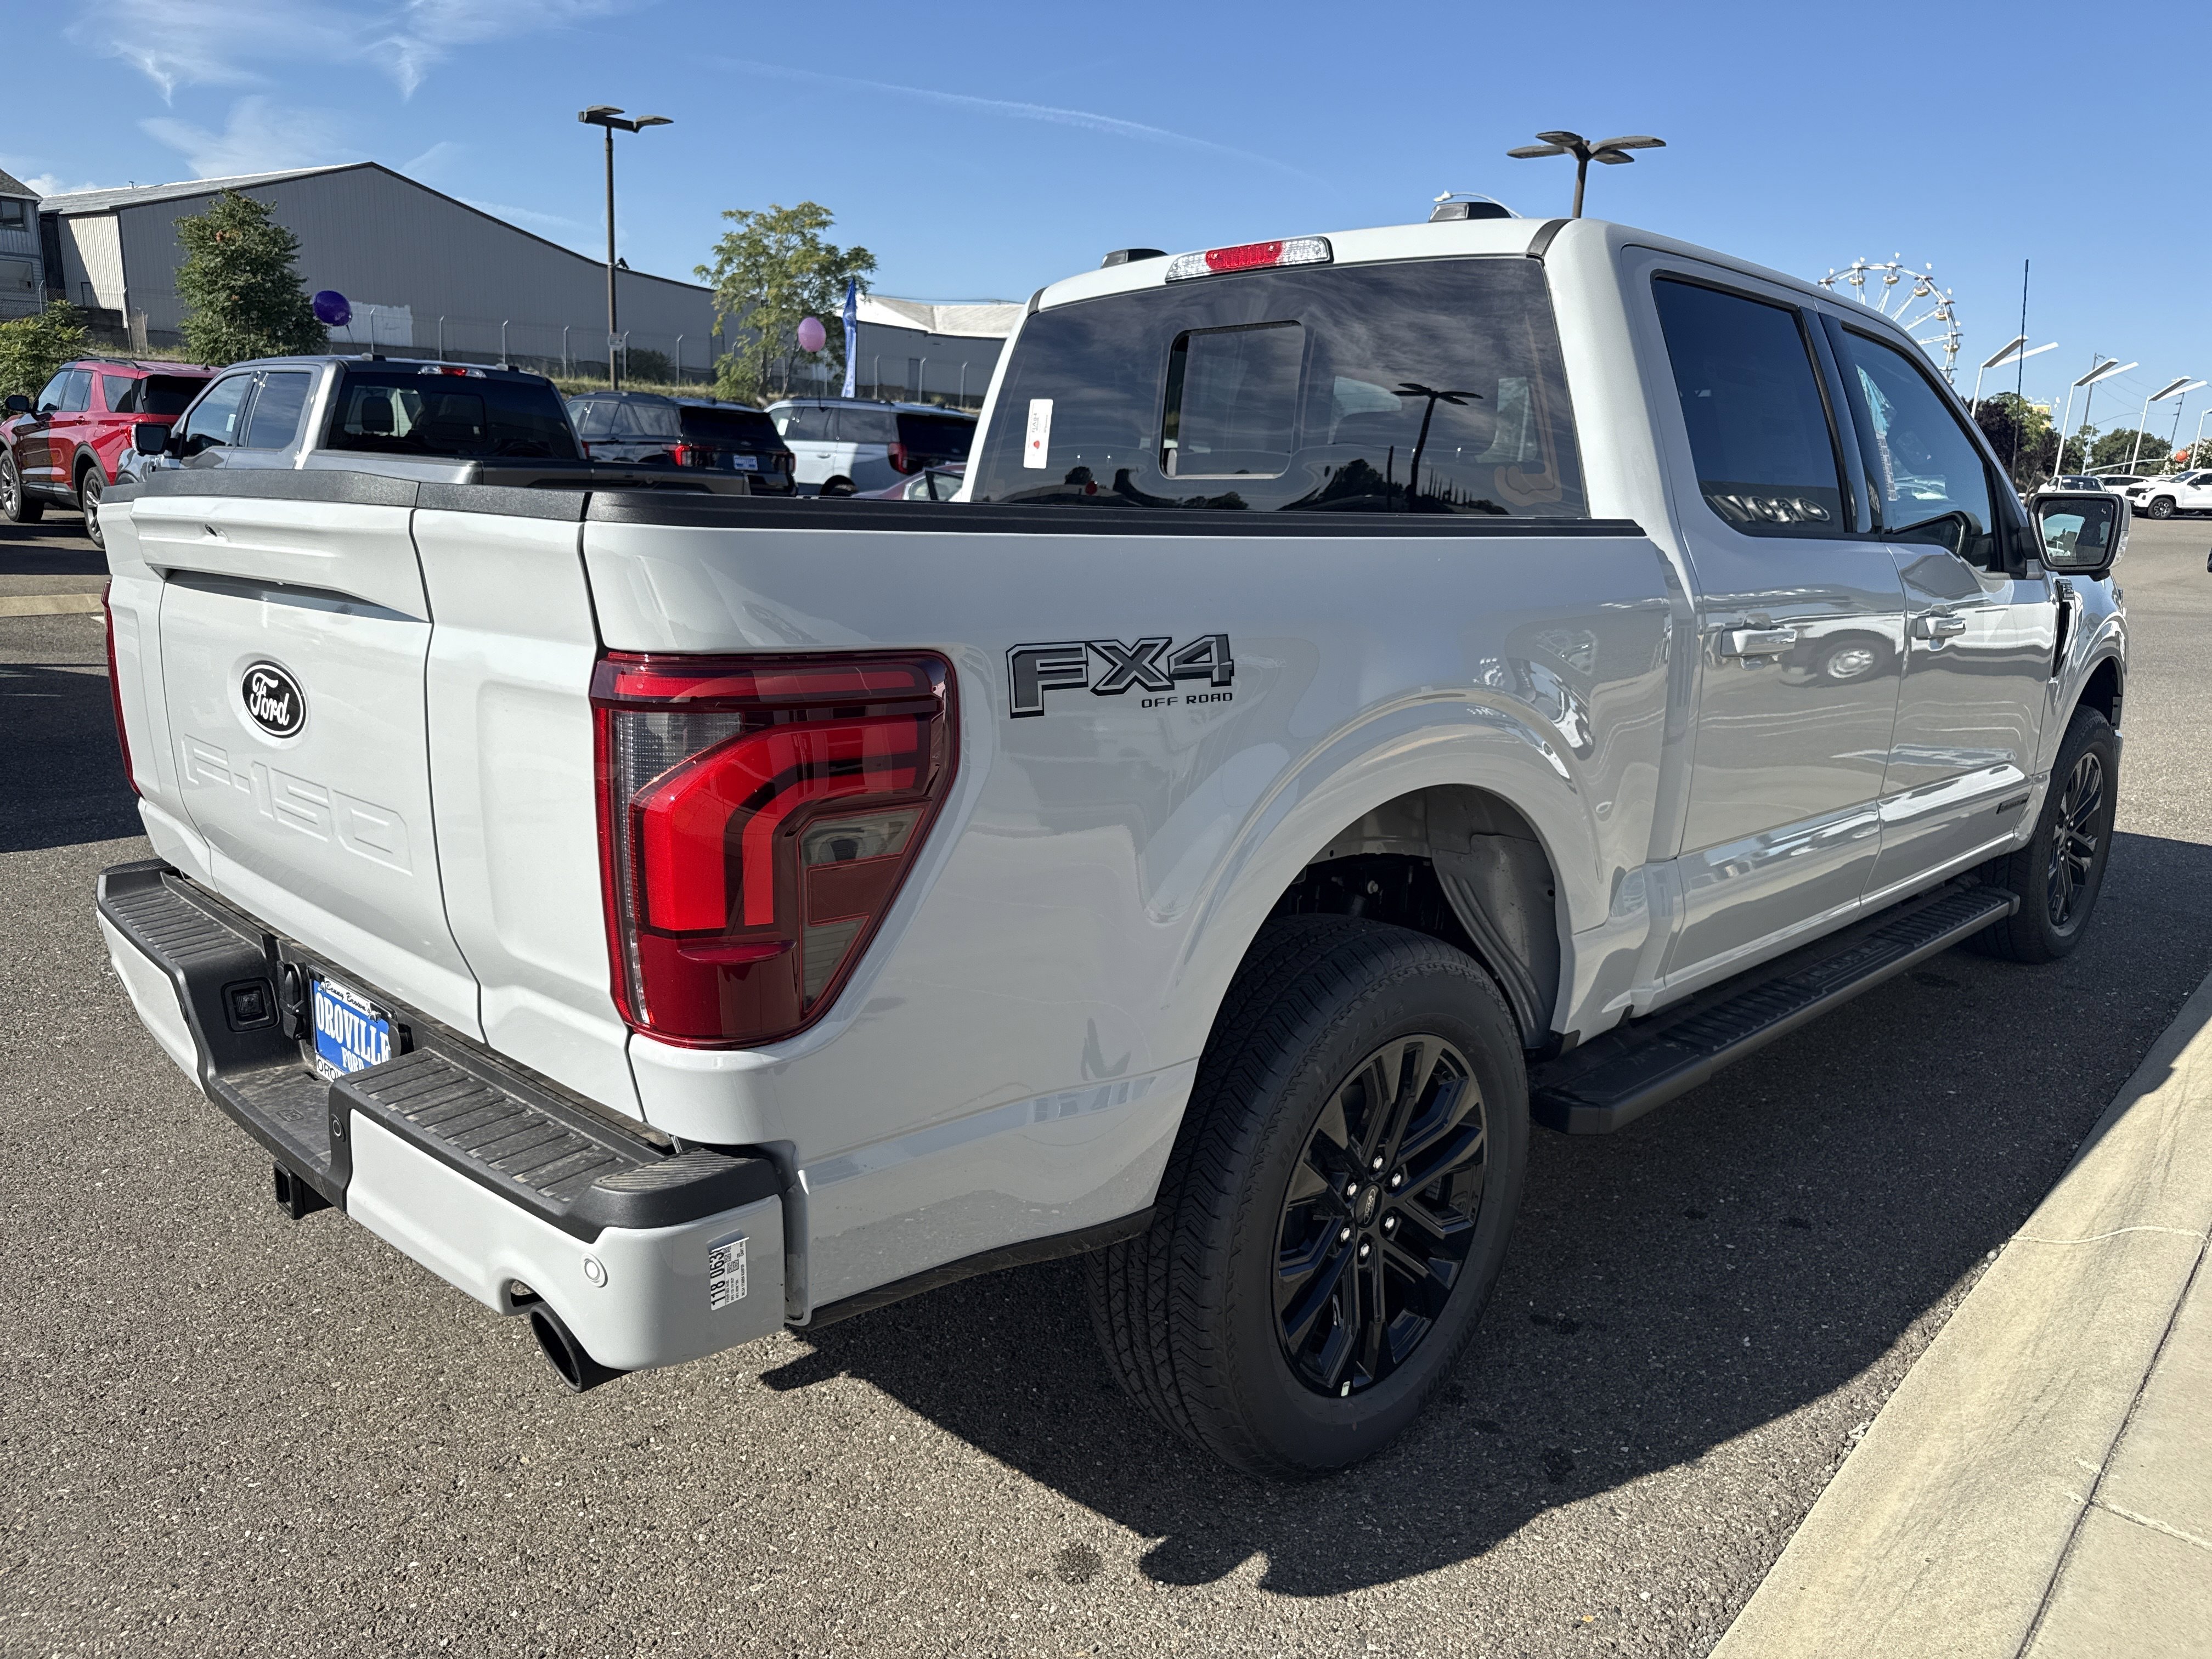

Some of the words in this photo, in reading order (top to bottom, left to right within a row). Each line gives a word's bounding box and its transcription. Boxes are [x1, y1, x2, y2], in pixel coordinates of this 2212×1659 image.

[1006, 634, 1234, 719] FX4
[1141, 696, 1178, 708] OFF
[1186, 692, 1233, 704] ROAD
[182, 733, 414, 876] F-150
[325, 981, 344, 1001] Benny
[346, 992, 373, 1013] Brown's
[711, 1280, 726, 1306] 118
